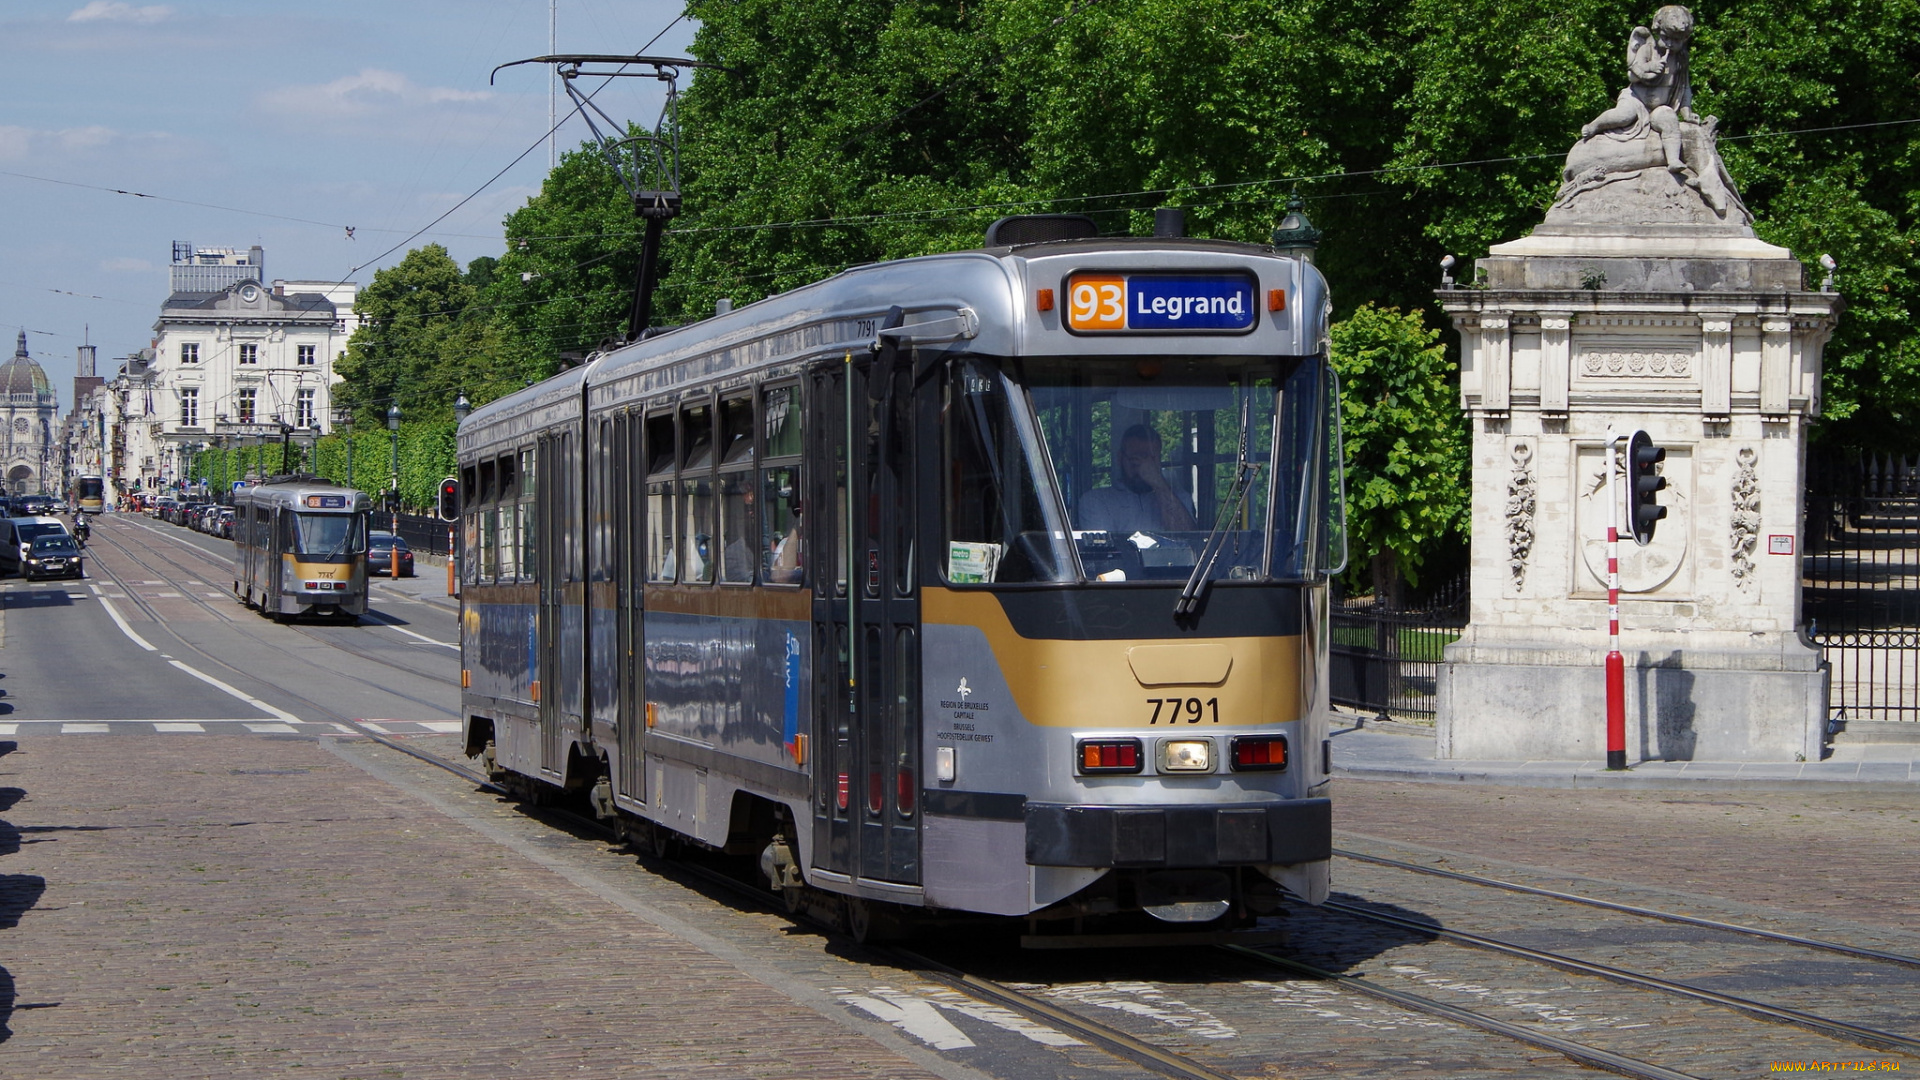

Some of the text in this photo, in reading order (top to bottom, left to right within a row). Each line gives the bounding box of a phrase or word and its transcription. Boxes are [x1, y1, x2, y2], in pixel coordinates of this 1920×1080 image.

[1073, 284, 1242, 322] 93 Legrand
[857, 319, 875, 338] 7791
[957, 701, 964, 709] DE
[964, 702, 989, 711] BRUXELLES
[1146, 697, 1219, 725] 7791
[953, 711, 975, 720] CAPITALE
[953, 723, 975, 732] BRUSSELS
[974, 734, 994, 743] GEWEST
